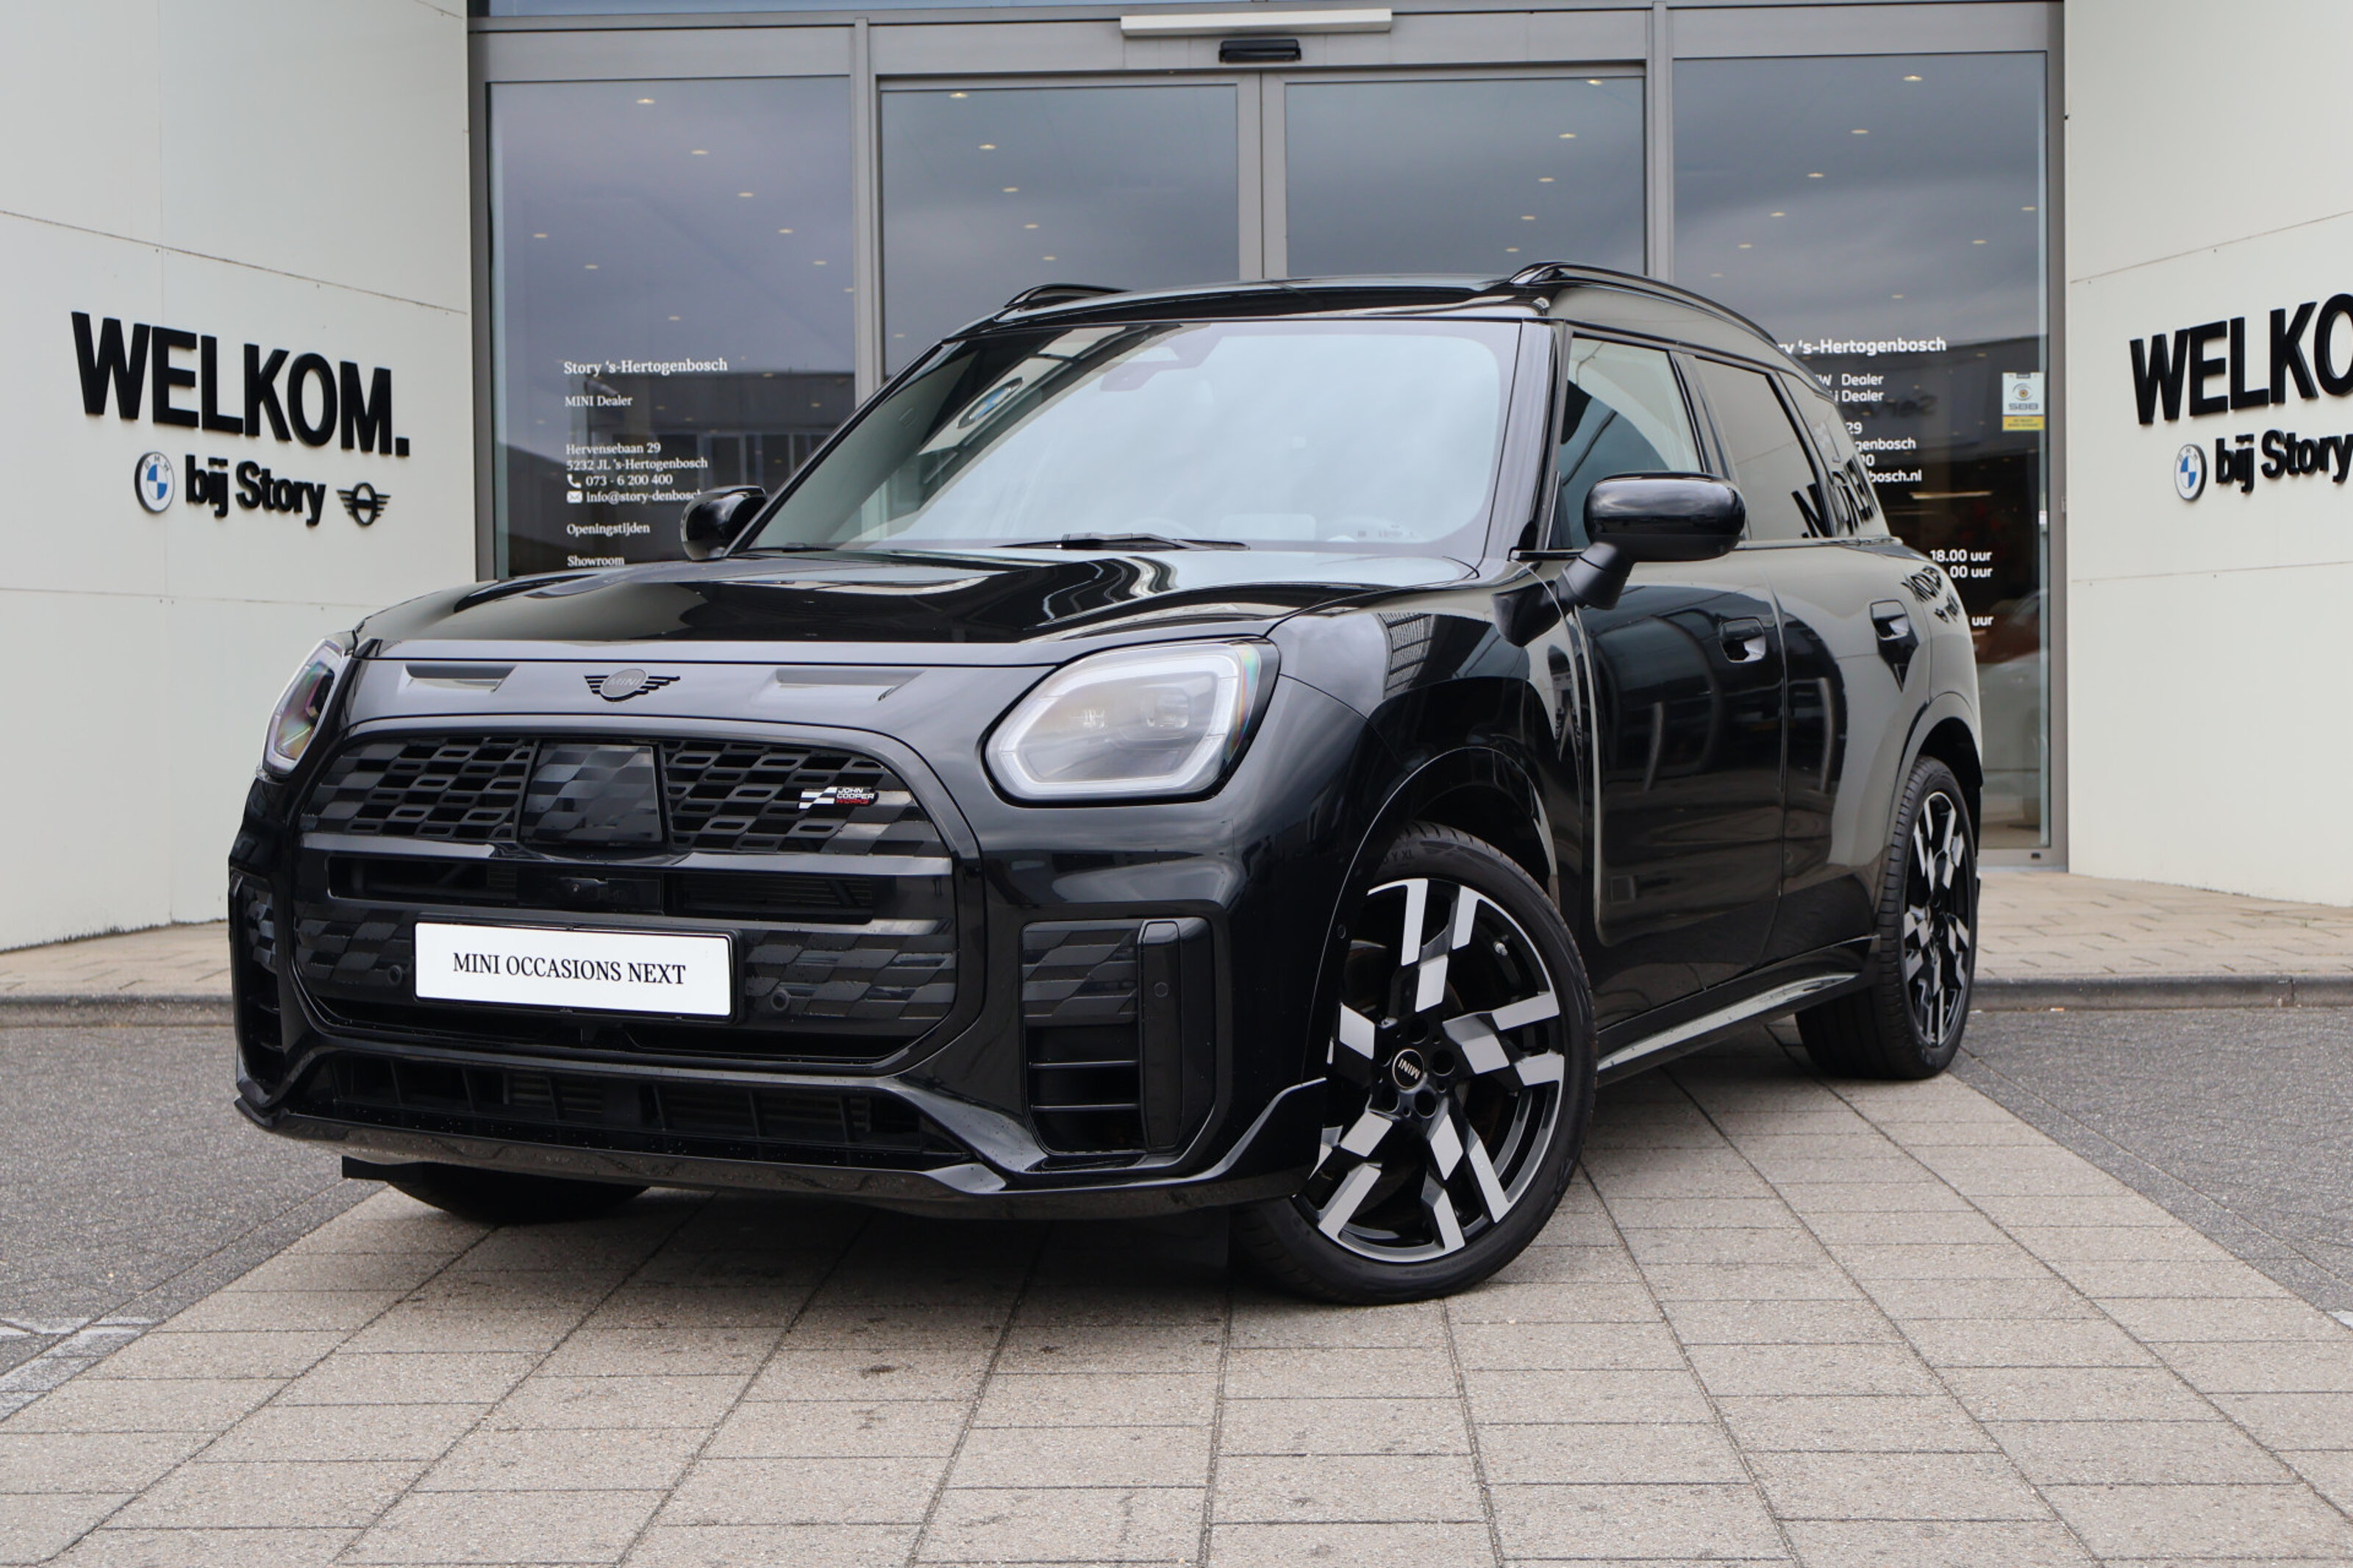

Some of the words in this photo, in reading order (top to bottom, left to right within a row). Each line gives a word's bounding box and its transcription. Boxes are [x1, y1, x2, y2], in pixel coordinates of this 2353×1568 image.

[2129, 293, 2353, 425] WELKO
[564, 362, 601, 377] Story
[71, 312, 410, 457] WELKOM.
[1842, 373, 1884, 386] Dealer
[565, 396, 593, 407] MINI
[597, 395, 633, 406] Dealer
[1842, 390, 1885, 402] Dealer
[566, 443, 644, 455] Hervensebaan
[646, 443, 661, 453] 29
[567, 460, 594, 470] 5232
[596, 459, 611, 470] JL
[2215, 434, 2254, 493] bij
[2260, 429, 2353, 484] Story
[586, 476, 607, 487] 073
[617, 475, 624, 485] 6
[628, 474, 649, 485] 200
[651, 473, 673, 484] 400
[185, 454, 228, 518] bij
[235, 461, 326, 527] Story
[567, 523, 650, 537] Openingstijden
[567, 555, 625, 567] Showroom
[1929, 549, 1967, 562] 18.00
[1970, 551, 1992, 562] uur
[1971, 568, 1993, 578] uur
[1971, 616, 1994, 626] uur
[453, 953, 500, 974] MINI
[507, 955, 622, 982] OCCASIONS
[627, 963, 686, 985] NEXT
[1398, 1059, 1421, 1080] MINI
